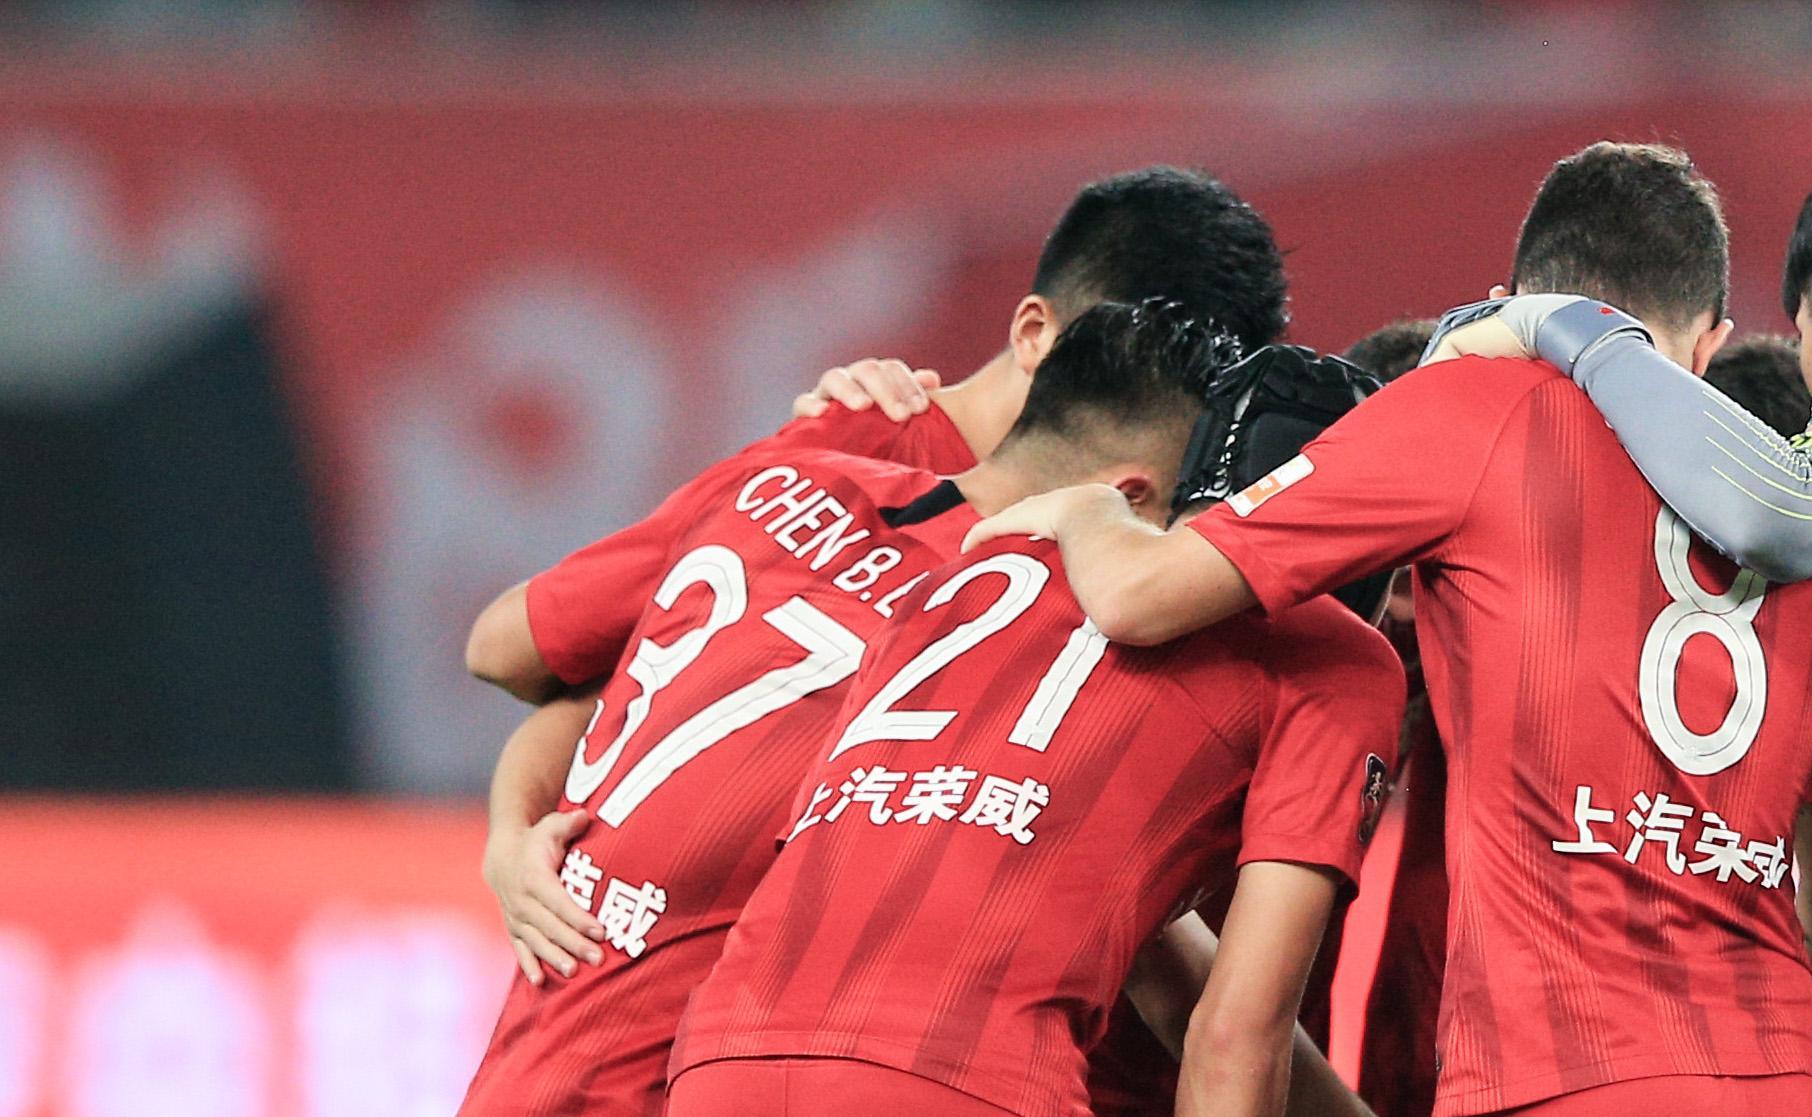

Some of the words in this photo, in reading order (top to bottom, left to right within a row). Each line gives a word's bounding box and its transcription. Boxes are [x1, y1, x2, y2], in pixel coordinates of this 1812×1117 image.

[735, 465, 871, 571] CHEN
[564, 543, 868, 829] 37
[828, 552, 1109, 763] 21
[1639, 503, 1768, 776] 8
